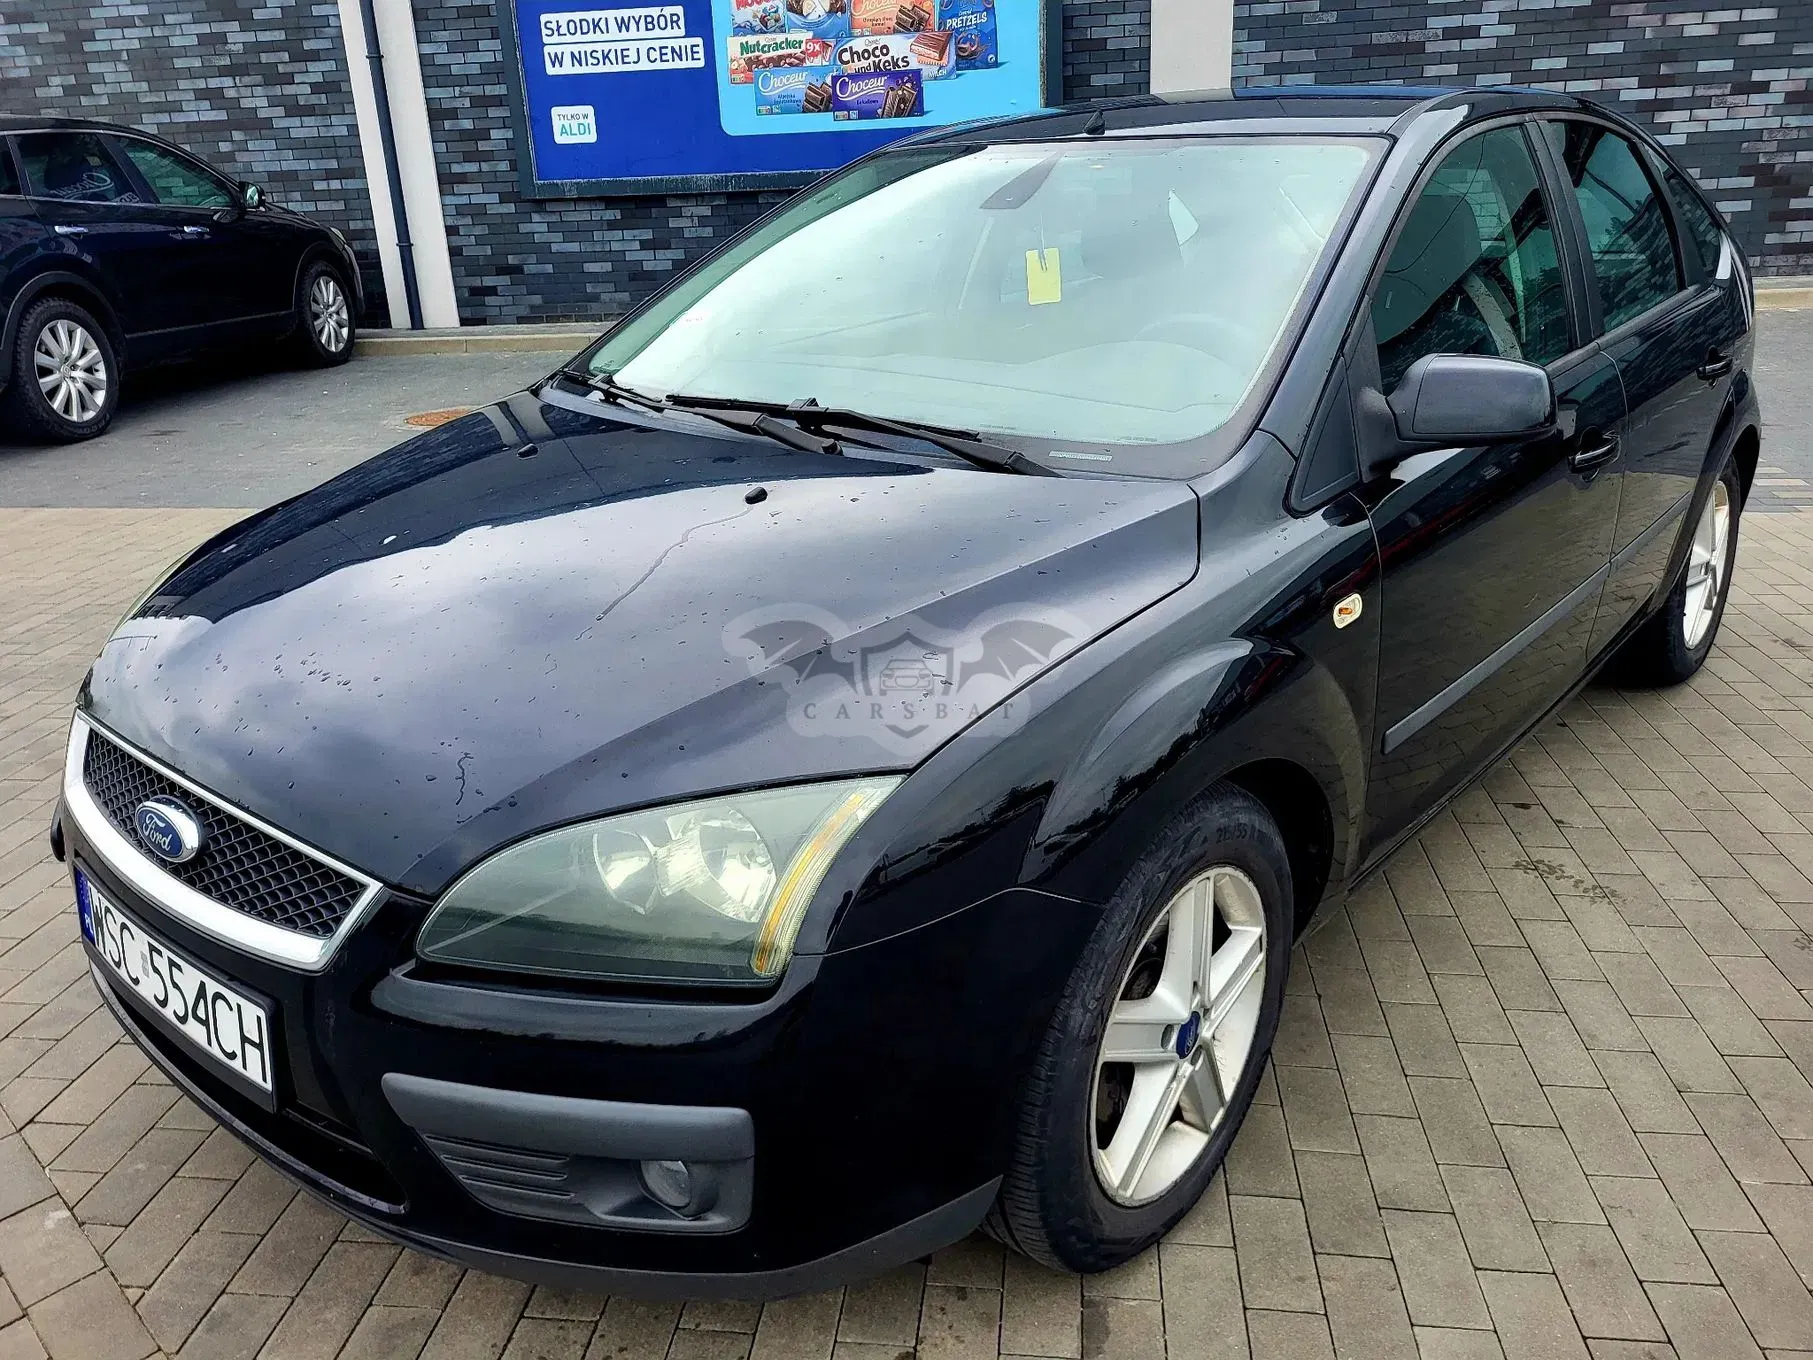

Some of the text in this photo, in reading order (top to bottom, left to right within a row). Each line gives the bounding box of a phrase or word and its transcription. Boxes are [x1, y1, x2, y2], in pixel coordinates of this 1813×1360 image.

[543, 8, 682, 37] SŁODKI WYBÓR
[946, 11, 987, 30] PRETZELS
[547, 44, 701, 68] W NISKIEJ CENIE
[739, 38, 804, 56] Nutcracker
[837, 44, 890, 65] Choco
[872, 55, 910, 72] Keks
[758, 71, 808, 92] Choceur
[836, 75, 888, 97] Choceur
[557, 113, 580, 121] TYLKO
[560, 123, 591, 137] ALDI
[143, 813, 173, 850] Ford
[90, 887, 267, 1084] WSC 554CH
